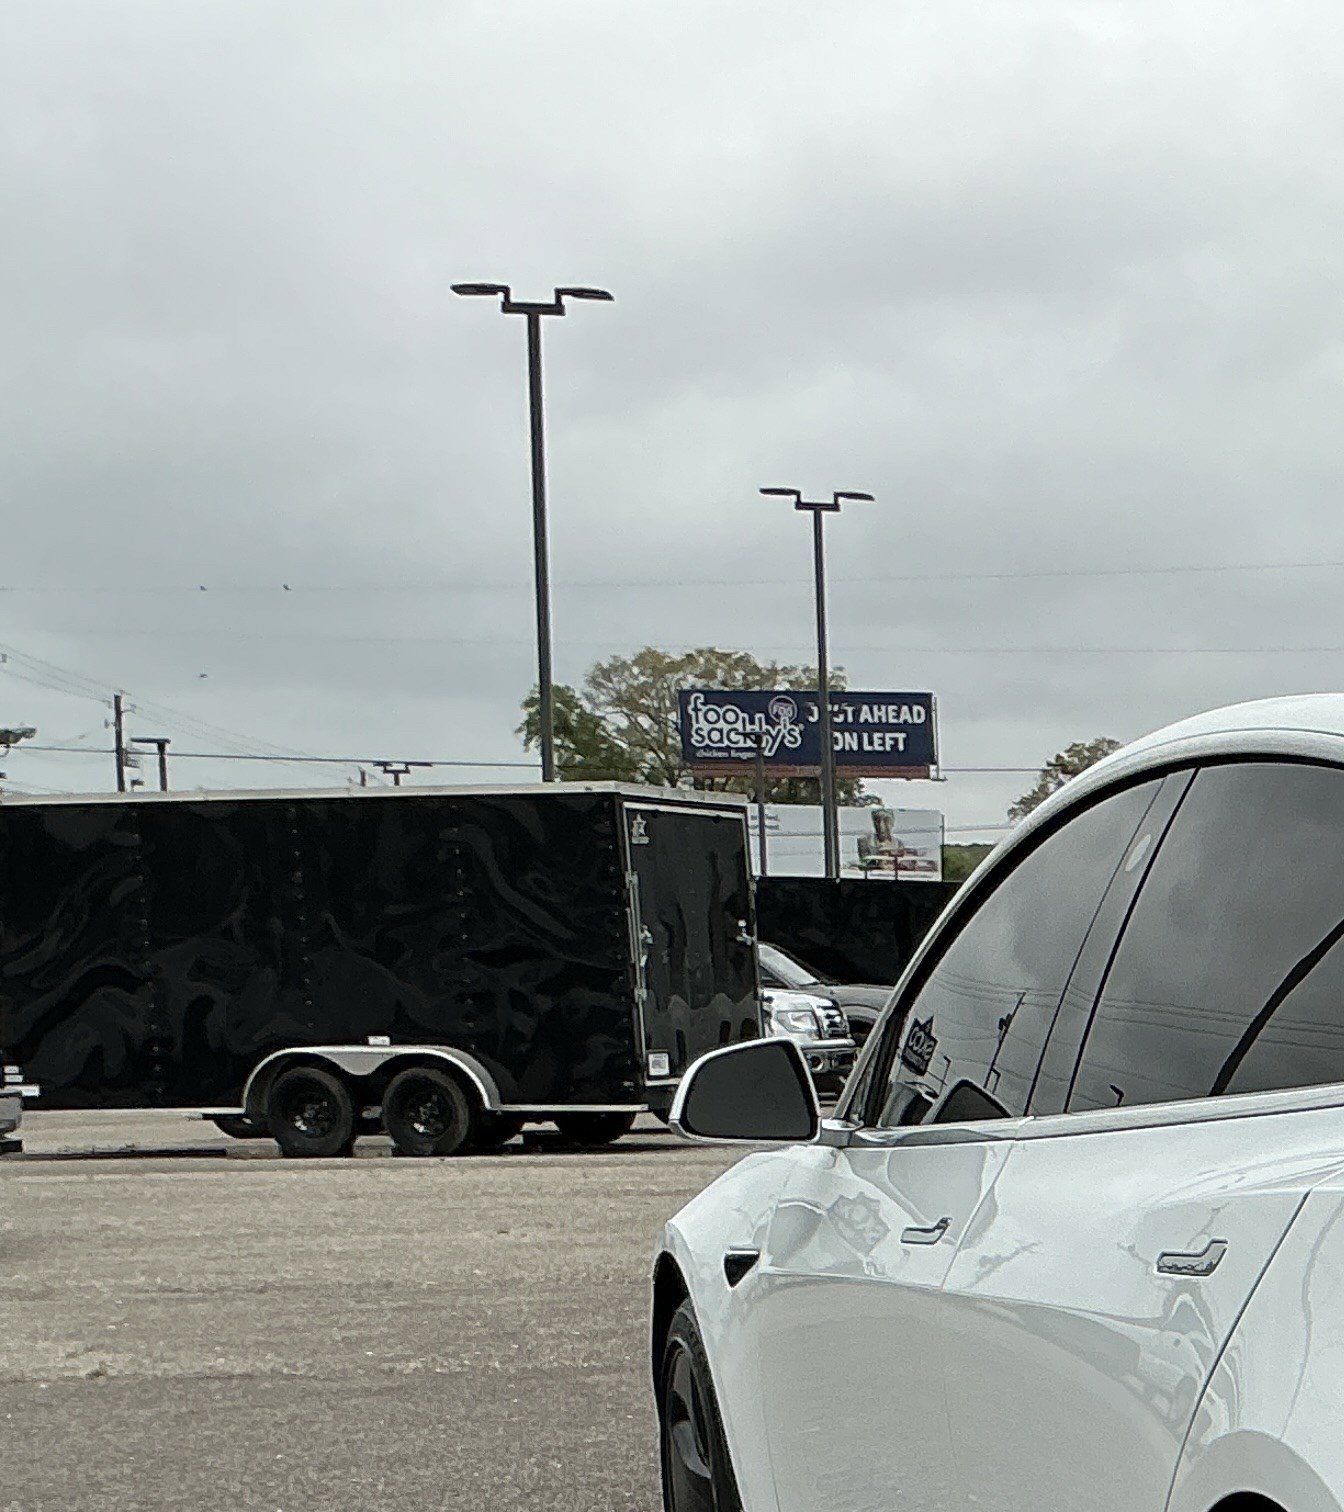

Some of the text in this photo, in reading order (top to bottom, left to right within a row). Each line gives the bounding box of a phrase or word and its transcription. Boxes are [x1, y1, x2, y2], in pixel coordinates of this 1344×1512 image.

[807, 702, 854, 723] JST
[860, 704, 926, 724] AHEAD
[862, 731, 907, 752] LEFT
